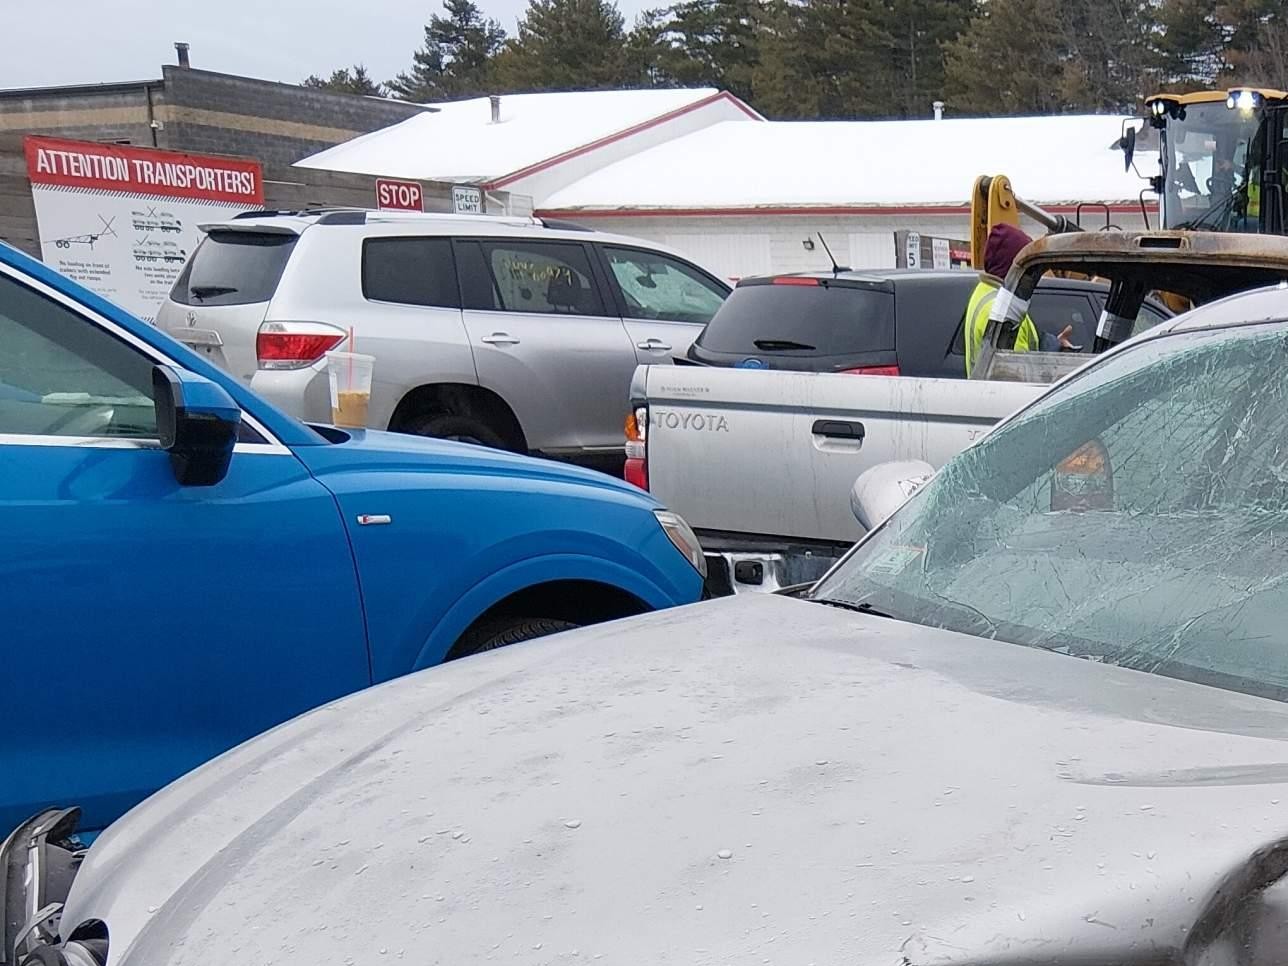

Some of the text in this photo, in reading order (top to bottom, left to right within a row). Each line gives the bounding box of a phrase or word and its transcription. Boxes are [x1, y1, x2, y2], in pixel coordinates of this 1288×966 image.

[37, 149, 255, 195] ATTENTION TRANSPORTERS!
[379, 184, 419, 206] STOP
[455, 193, 480, 203] SPEED
[457, 203, 478, 212] LIMIT
[908, 252, 916, 266] 5
[655, 410, 729, 432] TOYOTA
